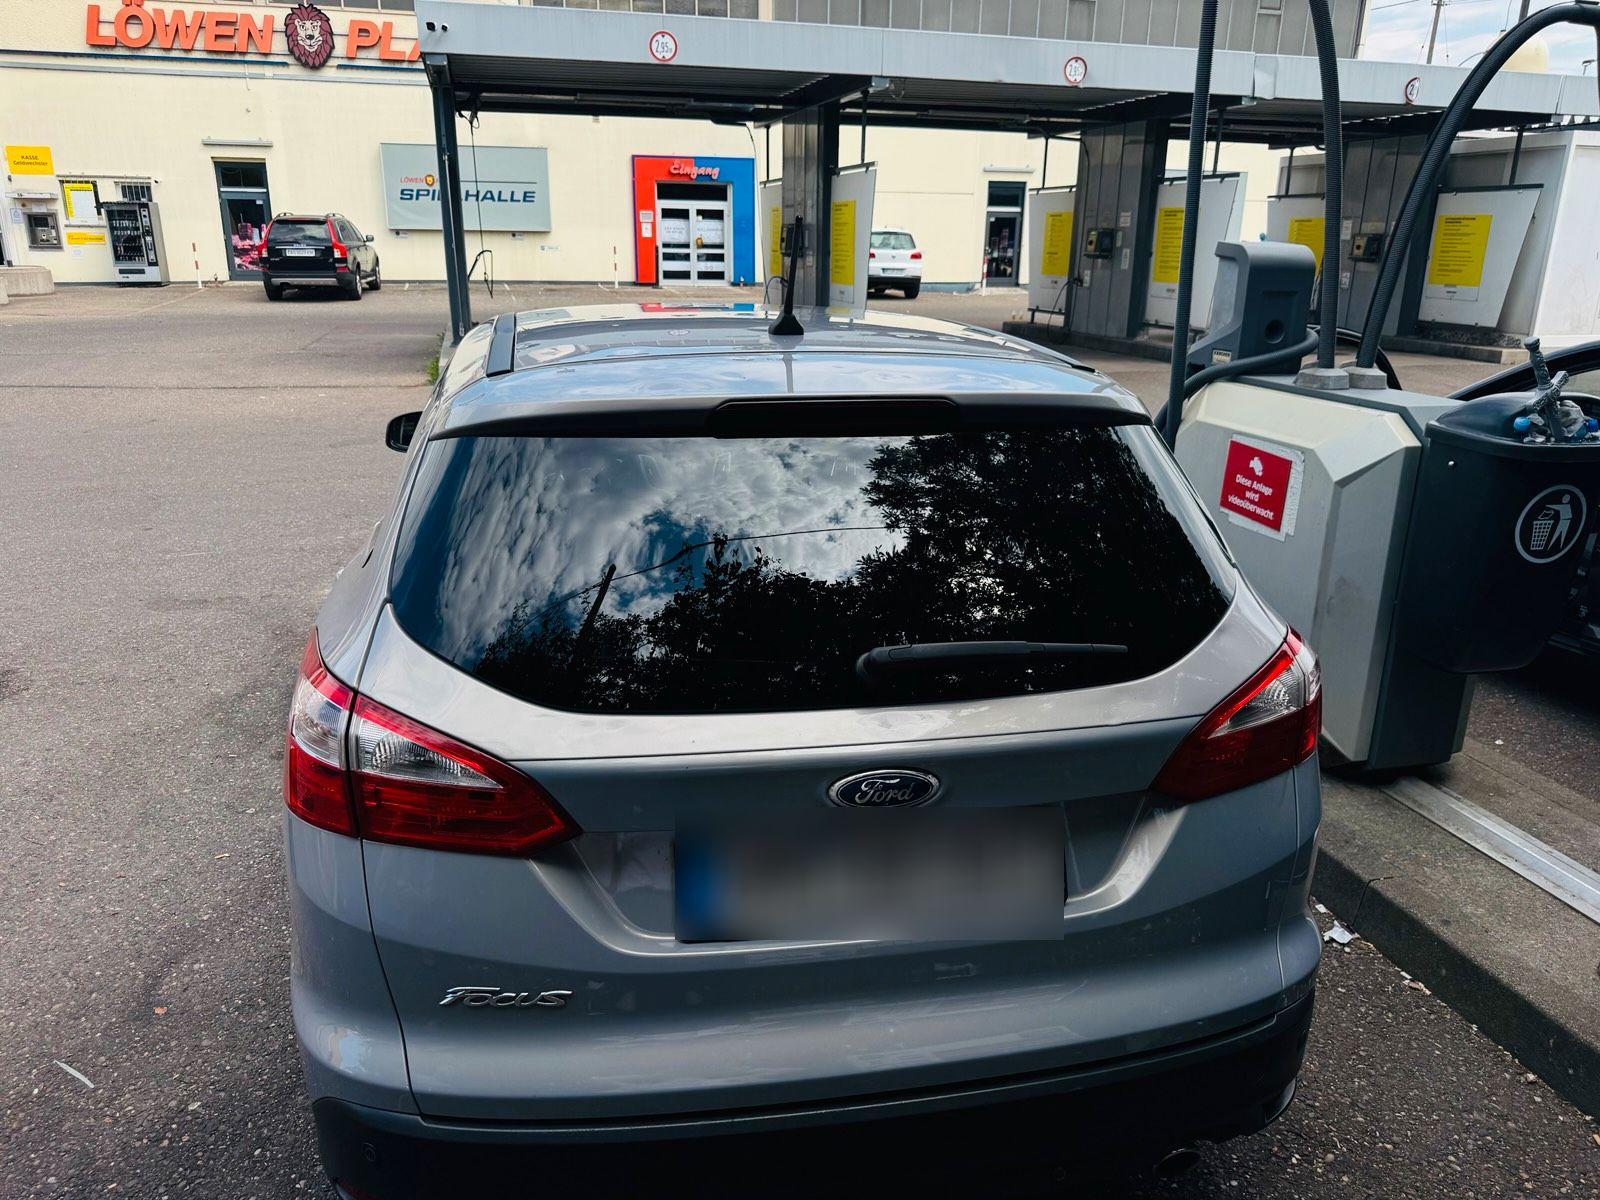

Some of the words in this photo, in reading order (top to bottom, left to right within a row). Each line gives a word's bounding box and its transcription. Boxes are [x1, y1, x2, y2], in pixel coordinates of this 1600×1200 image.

[86, 0, 275, 54] LÖWEN
[669, 160, 720, 180] Eingang
[400, 188, 536, 203] SPIHALLE
[1235, 473, 1252, 488] Diese
[1251, 480, 1273, 496] Anlage
[1245, 490, 1259, 502] wird
[1228, 494, 1274, 520] videoüberwacht
[855, 778, 916, 804] Ford
